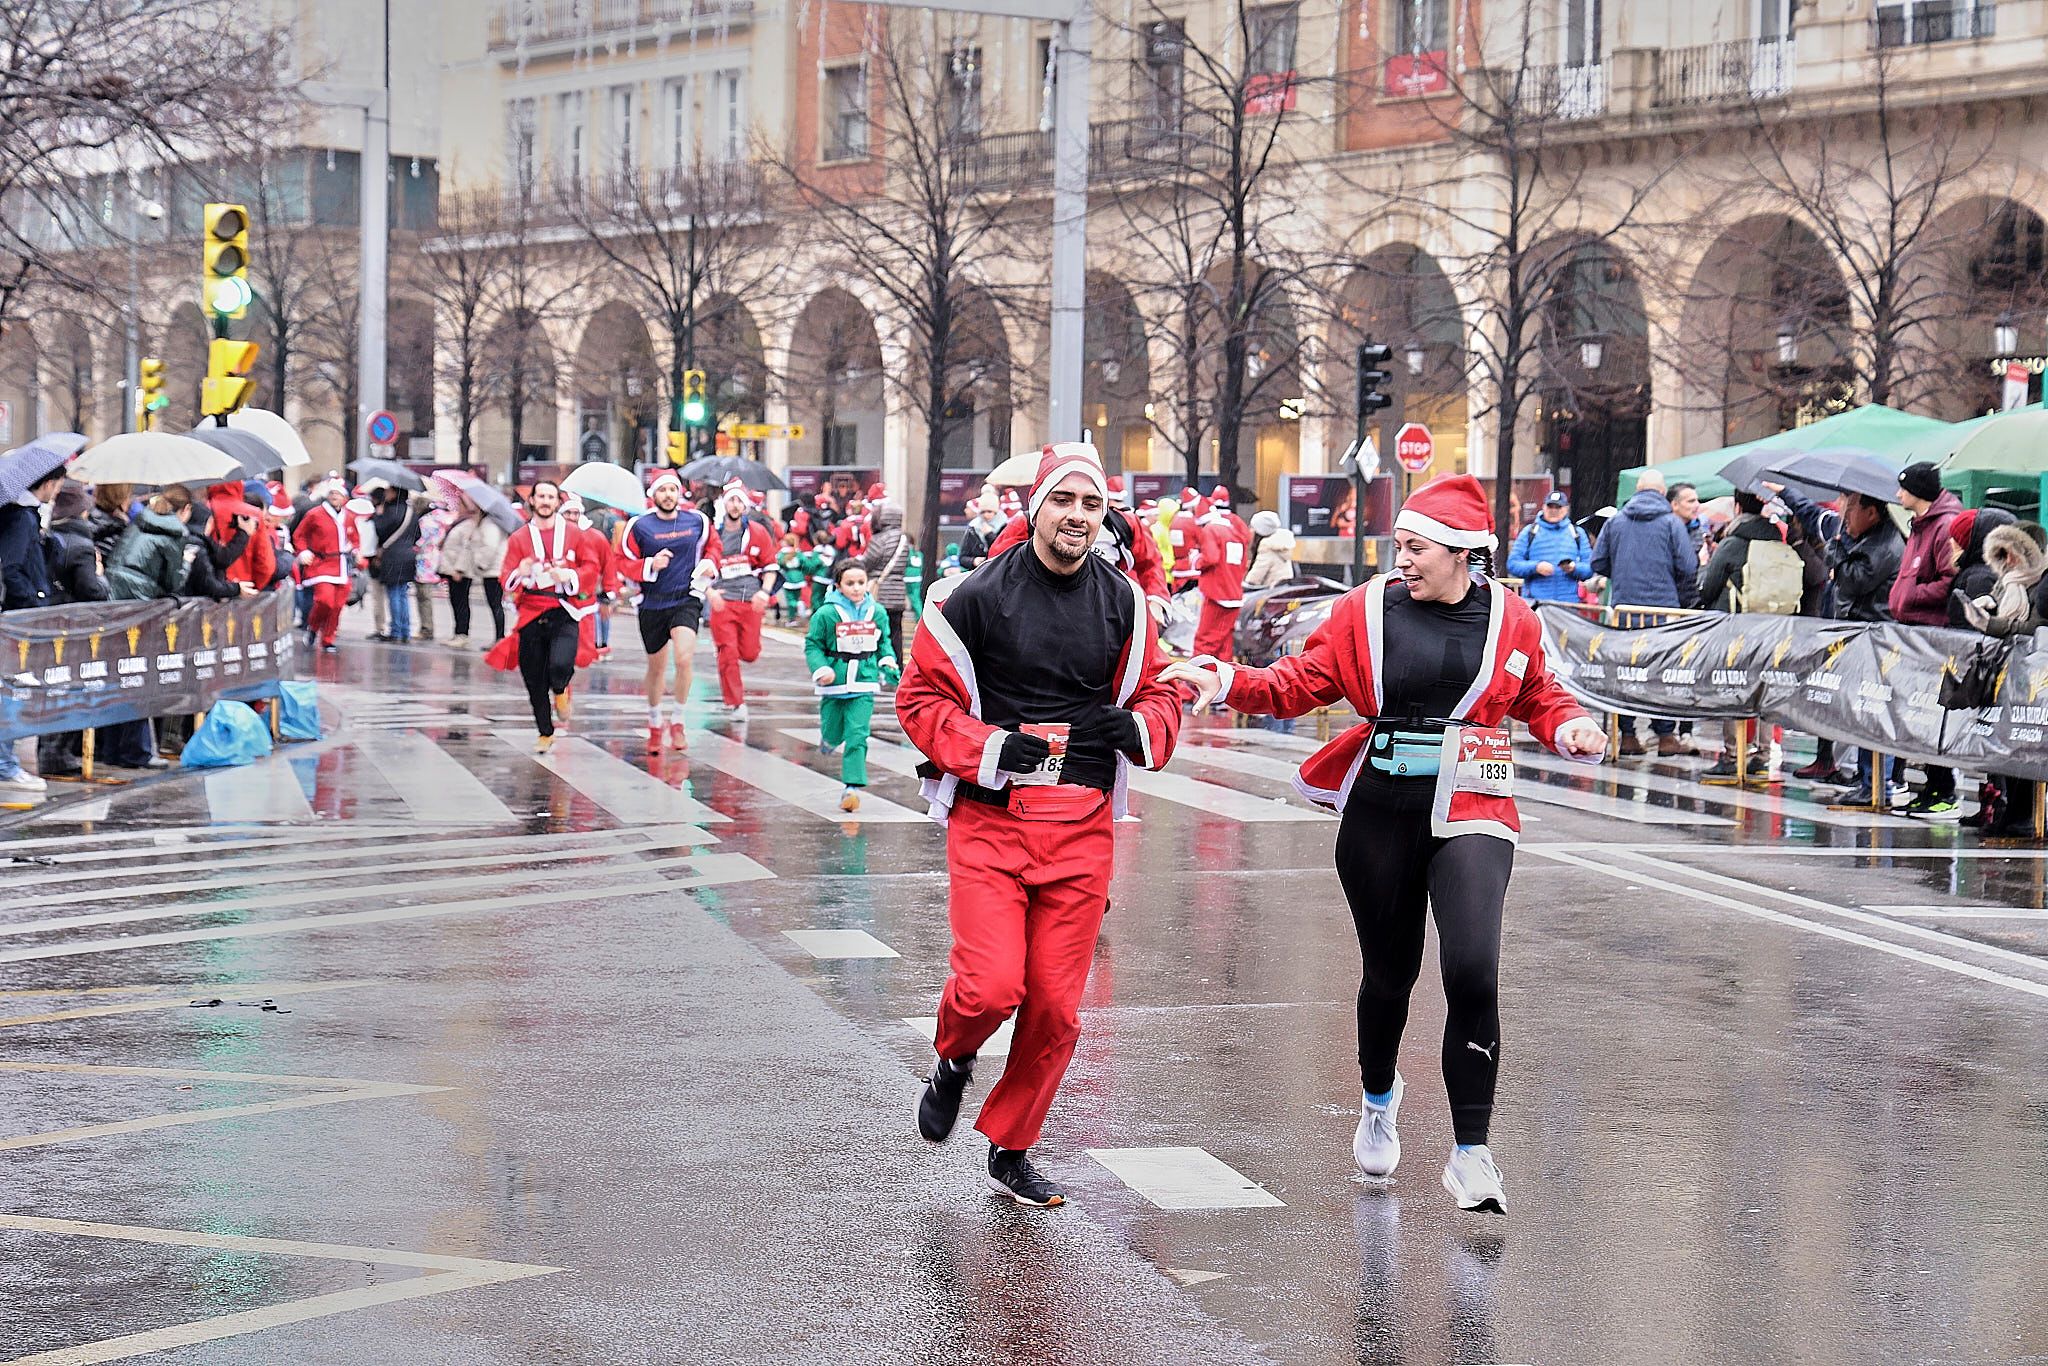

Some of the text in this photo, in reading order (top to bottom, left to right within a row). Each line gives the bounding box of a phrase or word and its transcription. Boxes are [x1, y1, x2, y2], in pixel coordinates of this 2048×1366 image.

[1401, 441, 1431, 455] STOP
[1485, 735, 1506, 748] Papá
[1480, 763, 1507, 780] 1839
